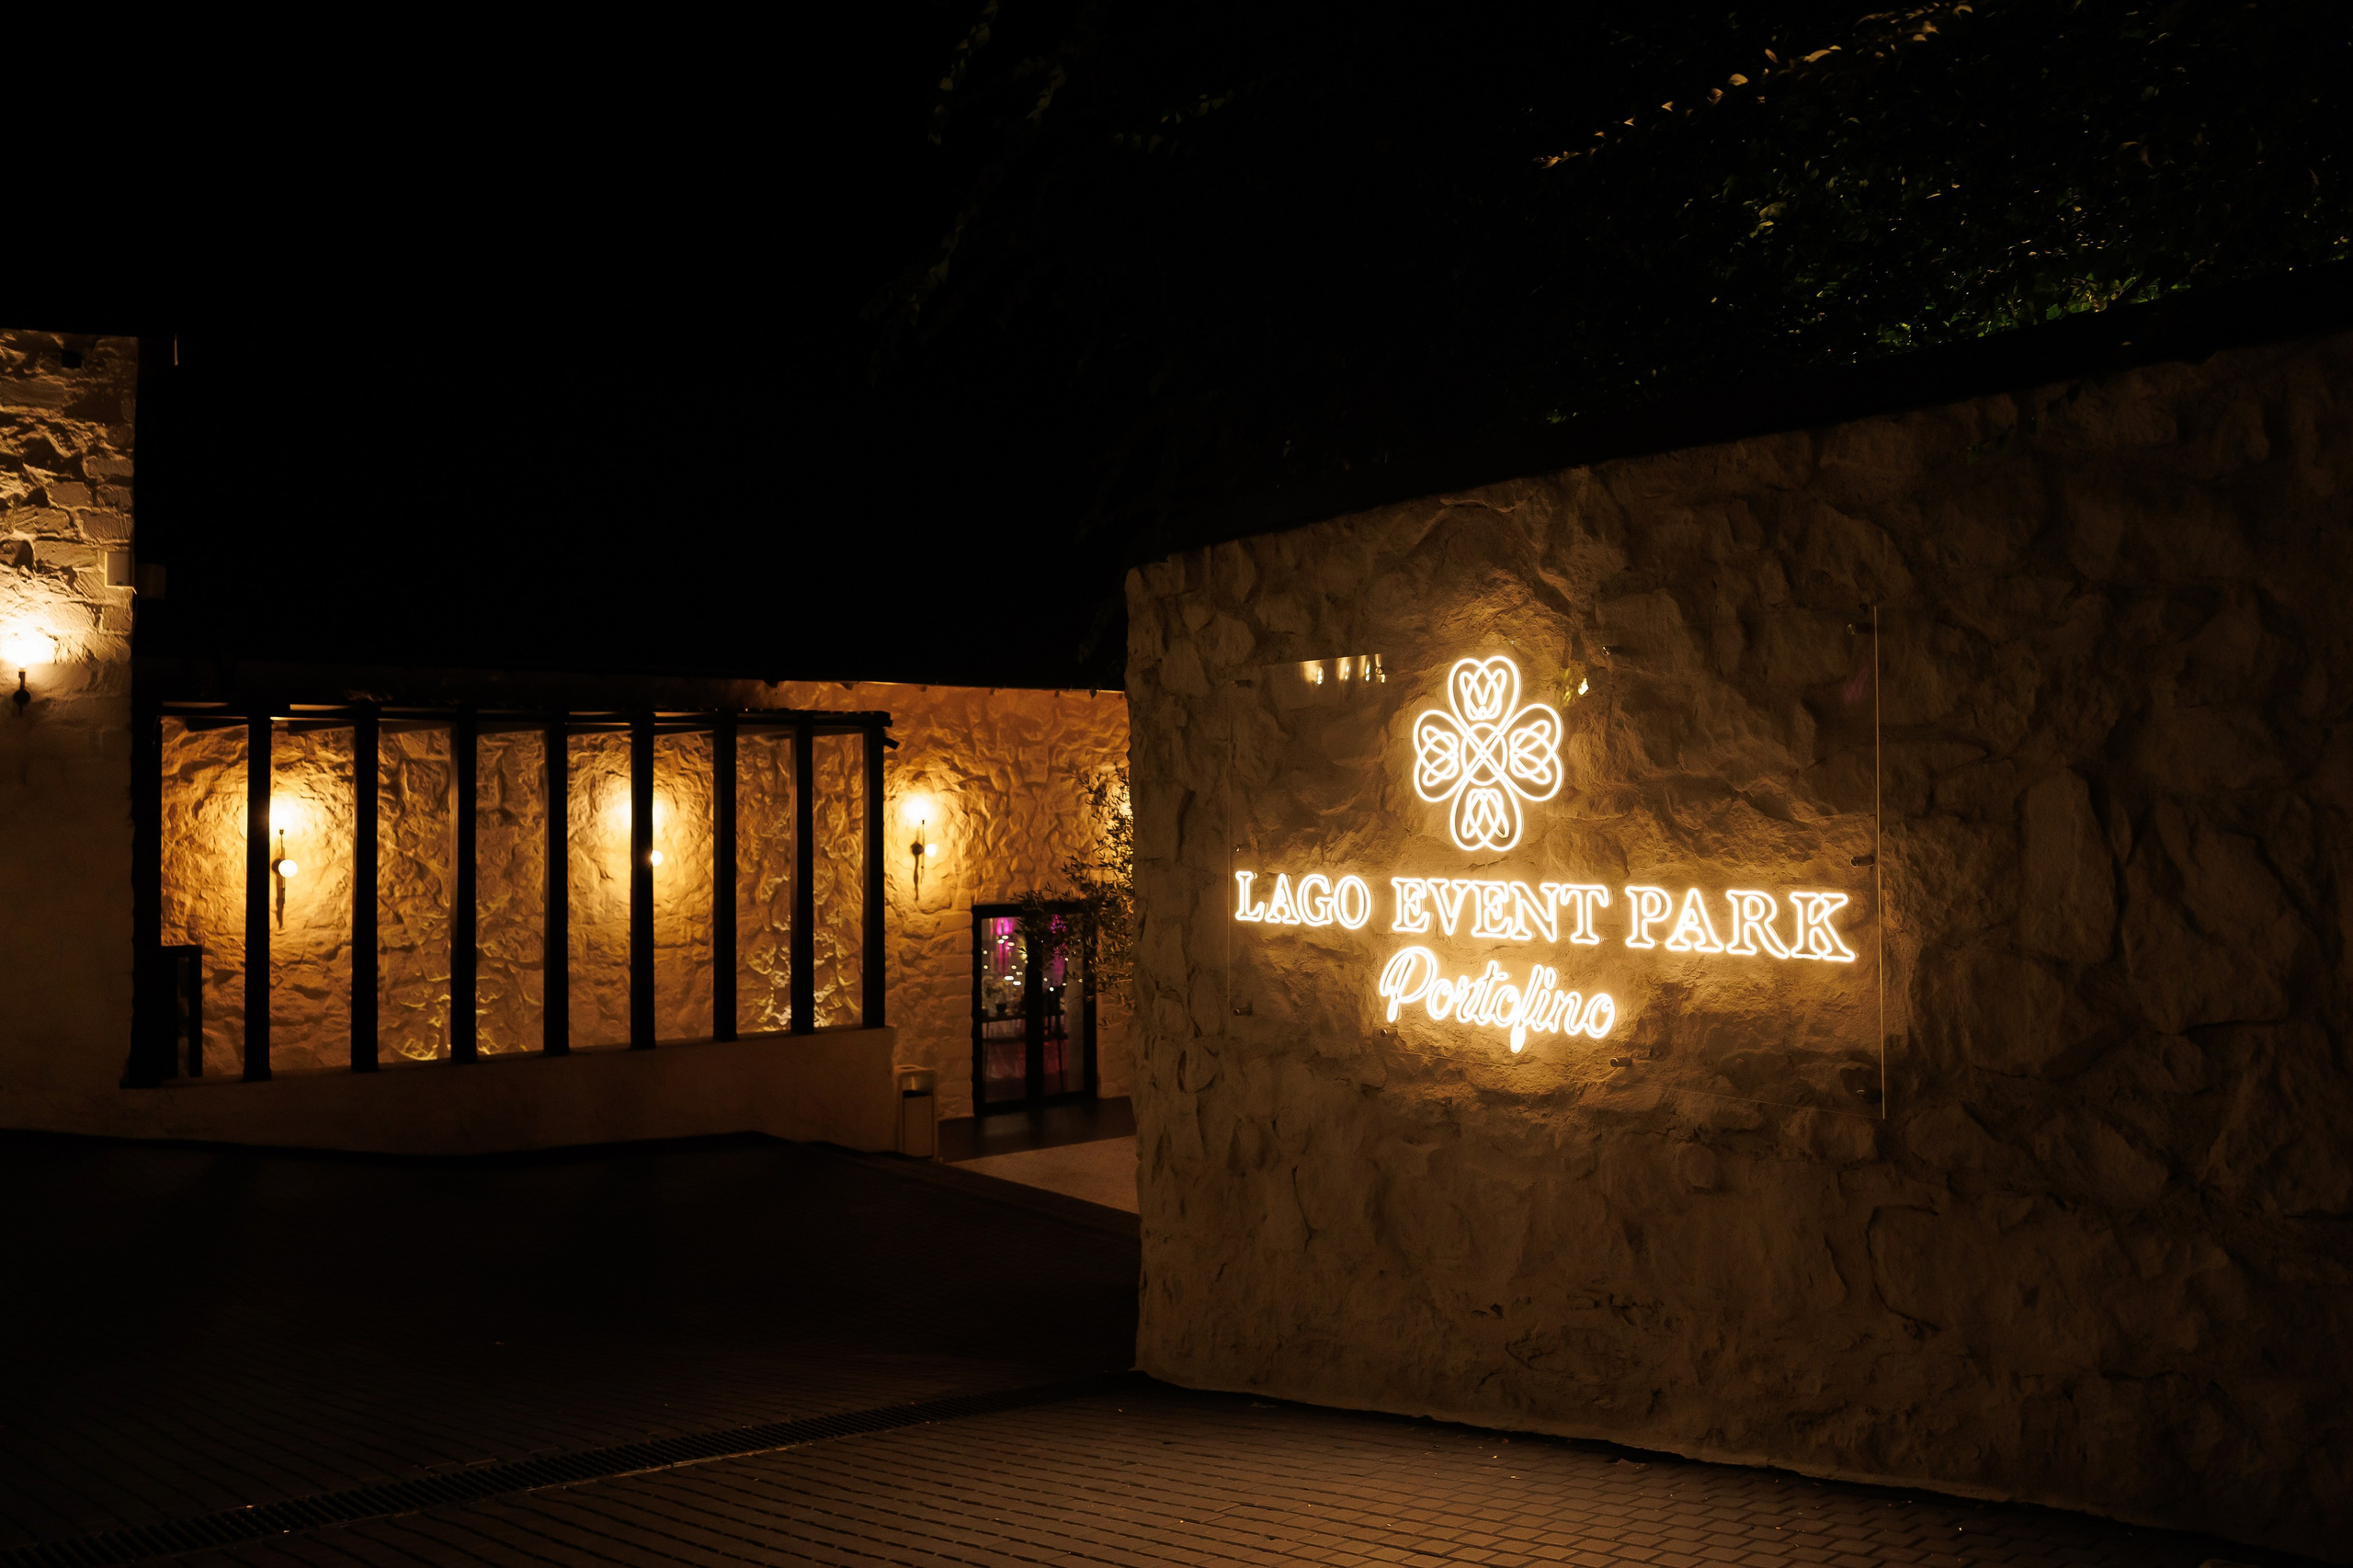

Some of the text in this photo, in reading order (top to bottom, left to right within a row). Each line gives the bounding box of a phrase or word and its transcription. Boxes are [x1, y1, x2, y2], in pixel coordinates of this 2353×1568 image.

[1234, 870, 1856, 962] LAGO EVENT PARK
[1379, 945, 1617, 1053] Portofino
